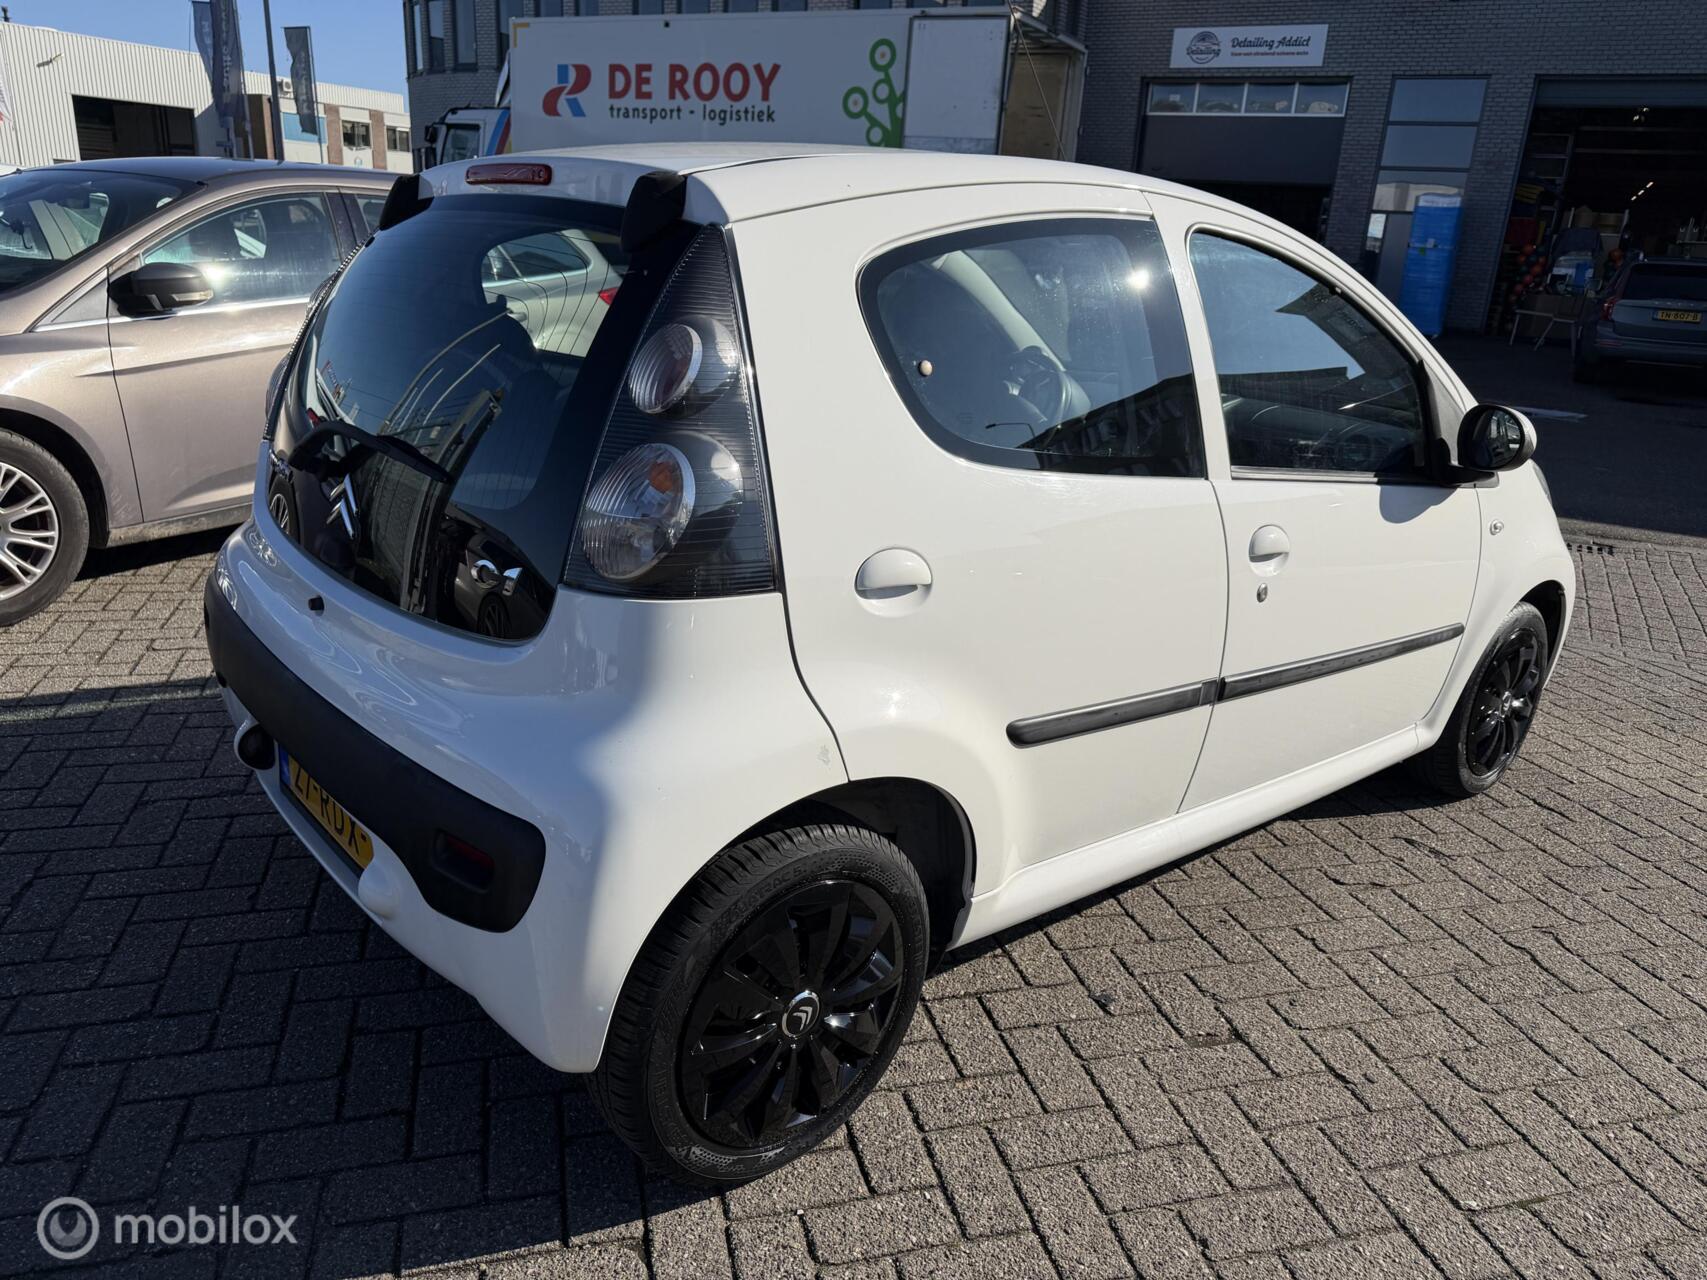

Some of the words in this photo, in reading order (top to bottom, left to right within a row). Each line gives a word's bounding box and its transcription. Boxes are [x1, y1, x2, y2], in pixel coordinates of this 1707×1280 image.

[1231, 37, 1274, 50] Detailing
[1276, 36, 1311, 48] Addict
[608, 64, 653, 100] DE
[668, 62, 781, 103] ROOY
[608, 105, 682, 124] transport
[702, 104, 775, 126] logistiek
